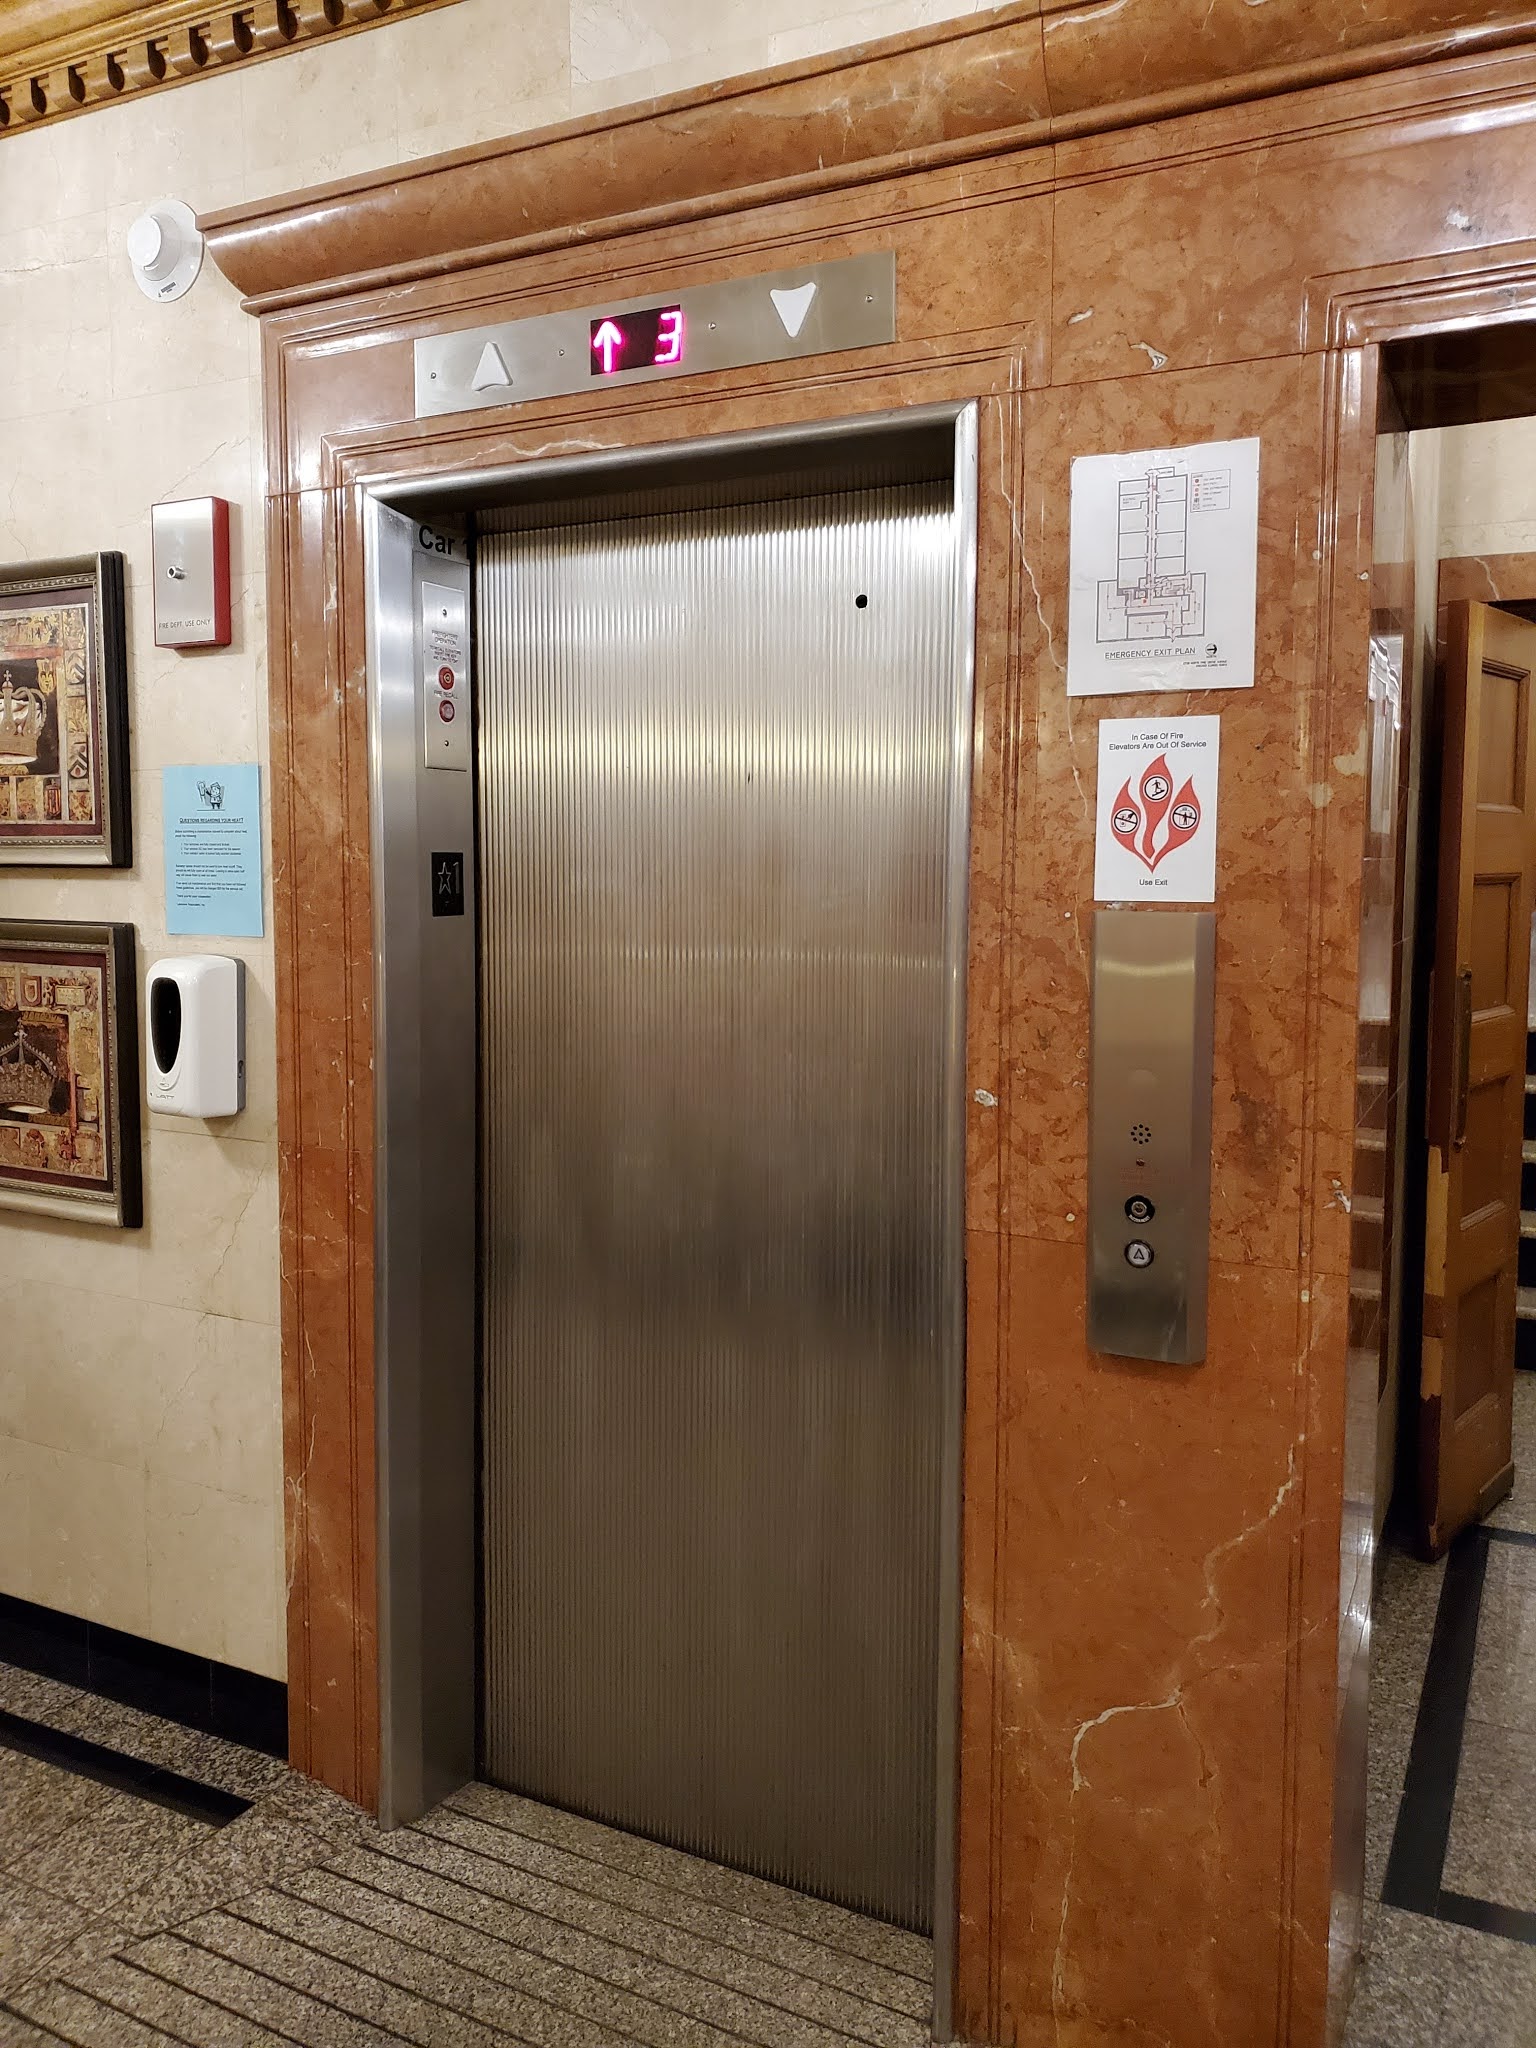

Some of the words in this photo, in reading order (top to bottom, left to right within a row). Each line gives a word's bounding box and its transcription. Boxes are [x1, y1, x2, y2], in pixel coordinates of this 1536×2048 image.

[655, 311, 683, 363] 3
[419, 525, 455, 555] Car
[184, 619, 195, 627] USE
[1105, 649, 1151, 659] EMERGENCY
[1154, 648, 1172, 656] EXIT
[1175, 647, 1196, 655] PLAN
[1180, 740, 1207, 748] Service
